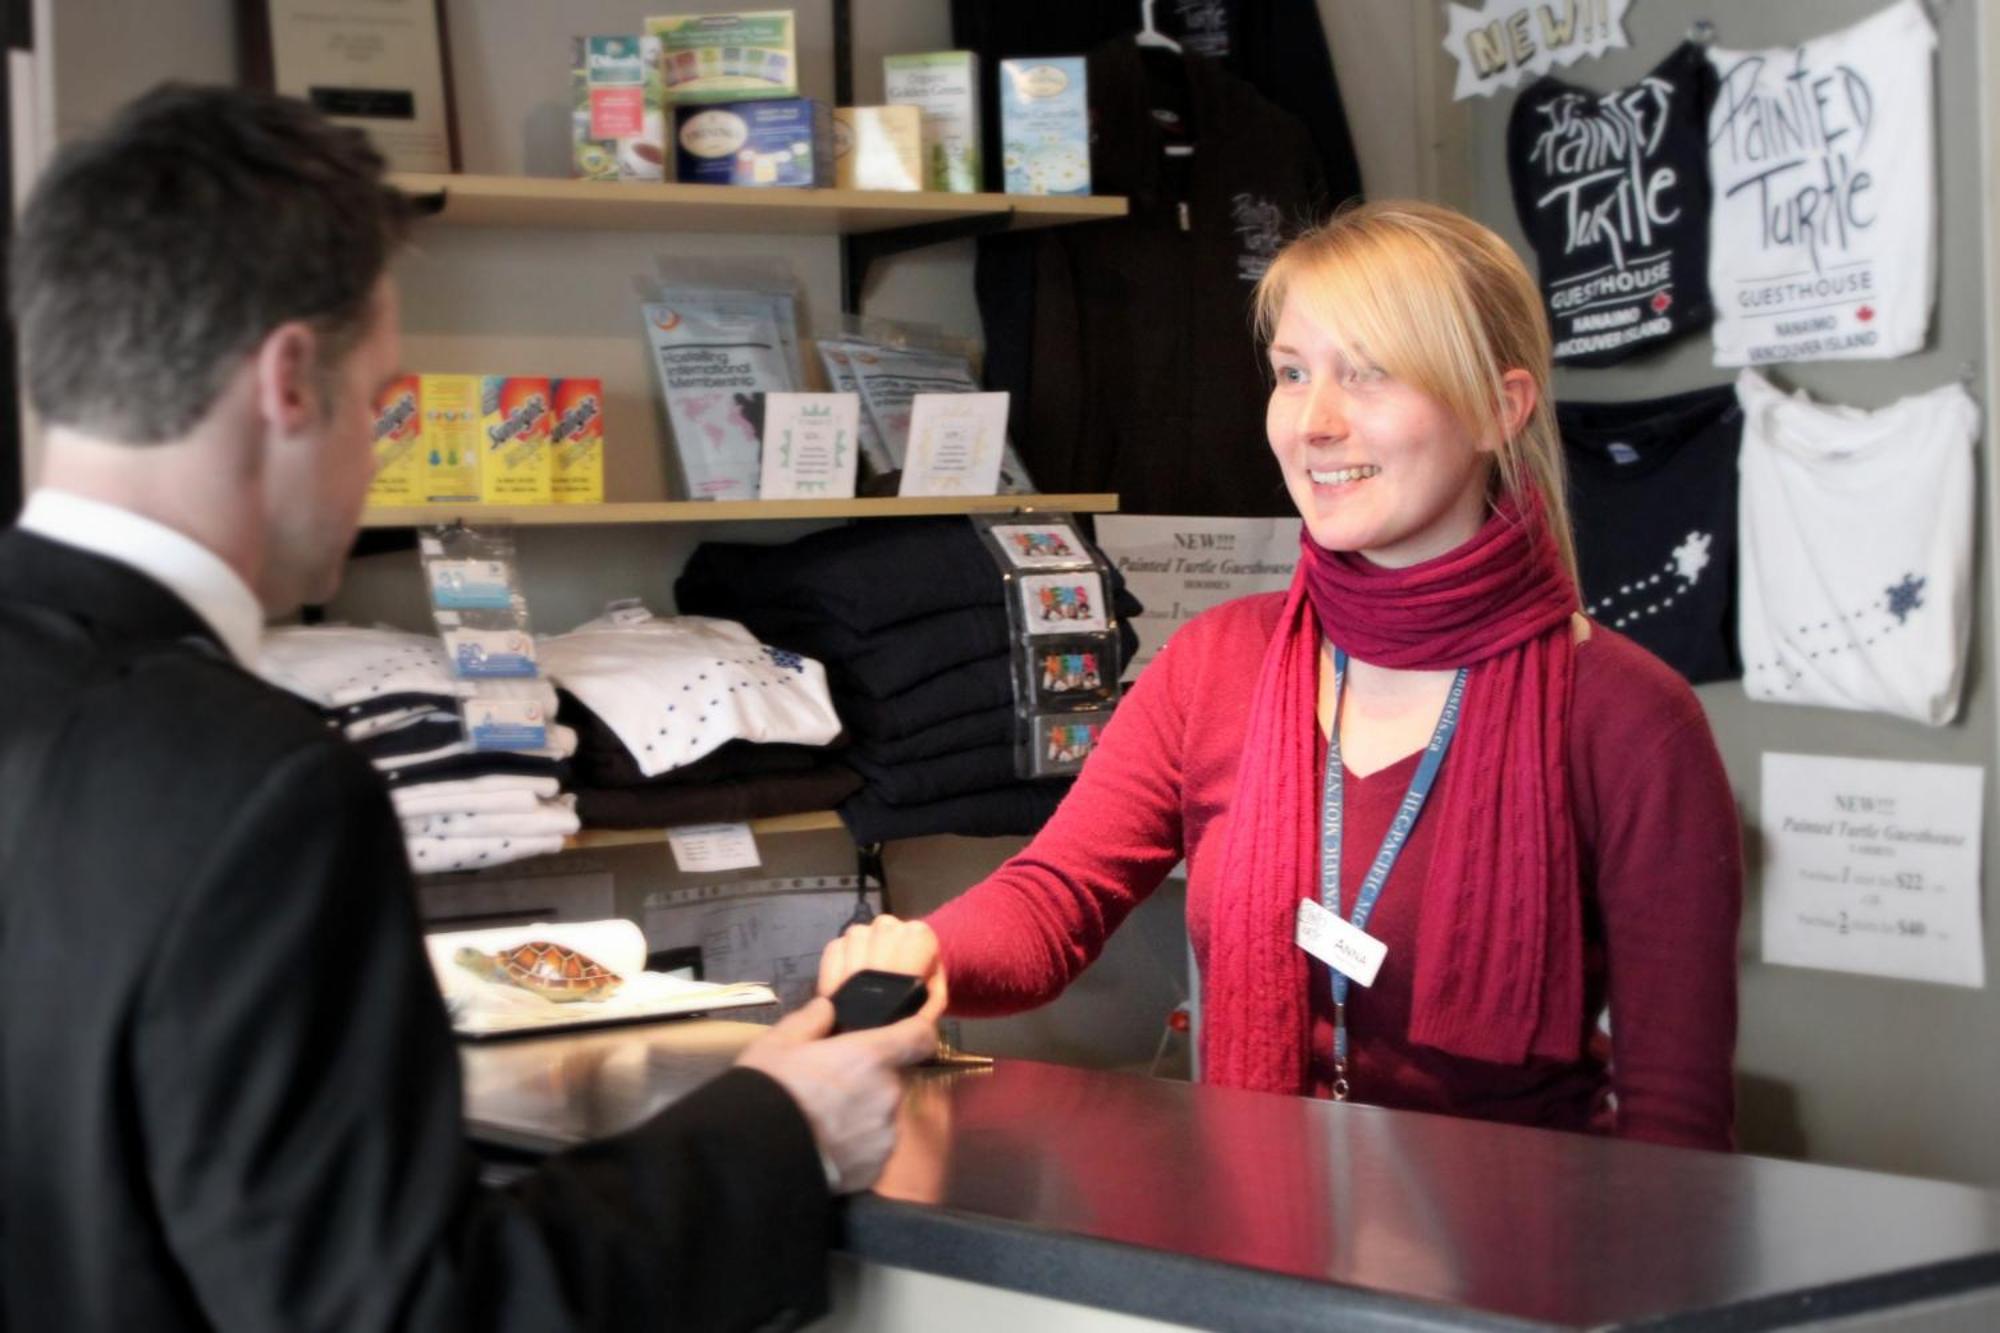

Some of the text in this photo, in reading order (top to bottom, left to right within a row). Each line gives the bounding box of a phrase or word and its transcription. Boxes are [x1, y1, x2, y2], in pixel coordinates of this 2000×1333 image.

[1551, 260, 1671, 309] GUESTHOUSE
[1738, 270, 1872, 308] GUESTHOUSE
[1173, 532, 1236, 551] NEW!!!
[1118, 556, 1173, 574] Painted
[1175, 557, 1218, 574] Turtle
